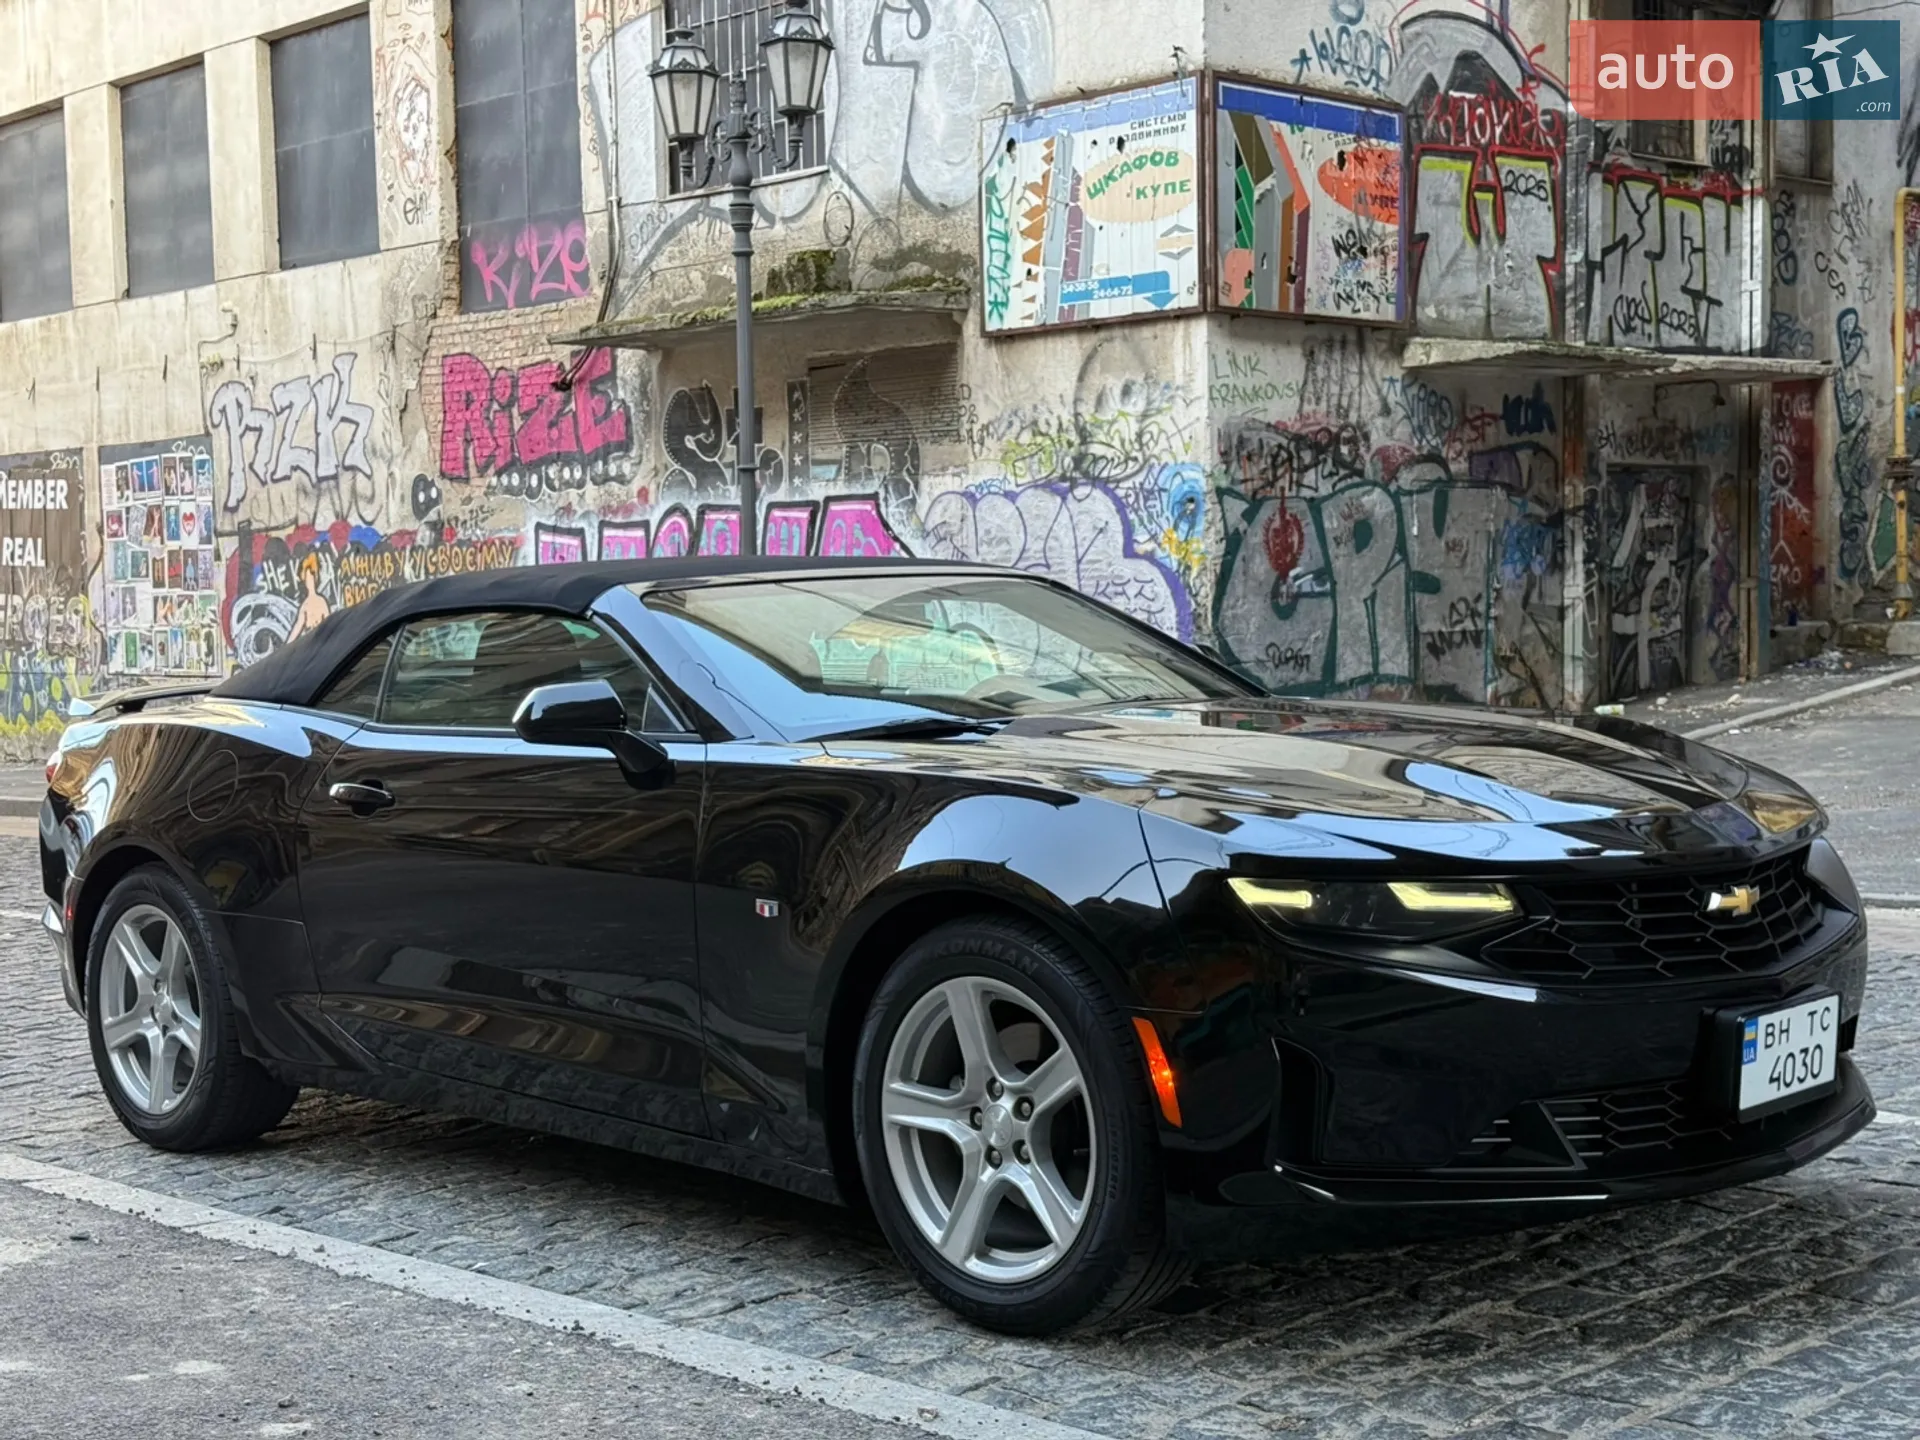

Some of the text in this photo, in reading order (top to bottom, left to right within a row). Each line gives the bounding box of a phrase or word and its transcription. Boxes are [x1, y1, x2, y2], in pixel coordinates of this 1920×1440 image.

[1109, 123, 1187, 145] РЗДВИЖНЫХ
[1130, 112, 1187, 131] СИСТЕМЫ
[1086, 151, 1180, 200] ШКАФОВ
[1135, 178, 1191, 200] КУПЕ
[2, 536, 46, 567] REAL
[1764, 1006, 1831, 1050] BH TC
[1743, 1047, 1755, 1062] UA
[1768, 1043, 1823, 1092] 4030
